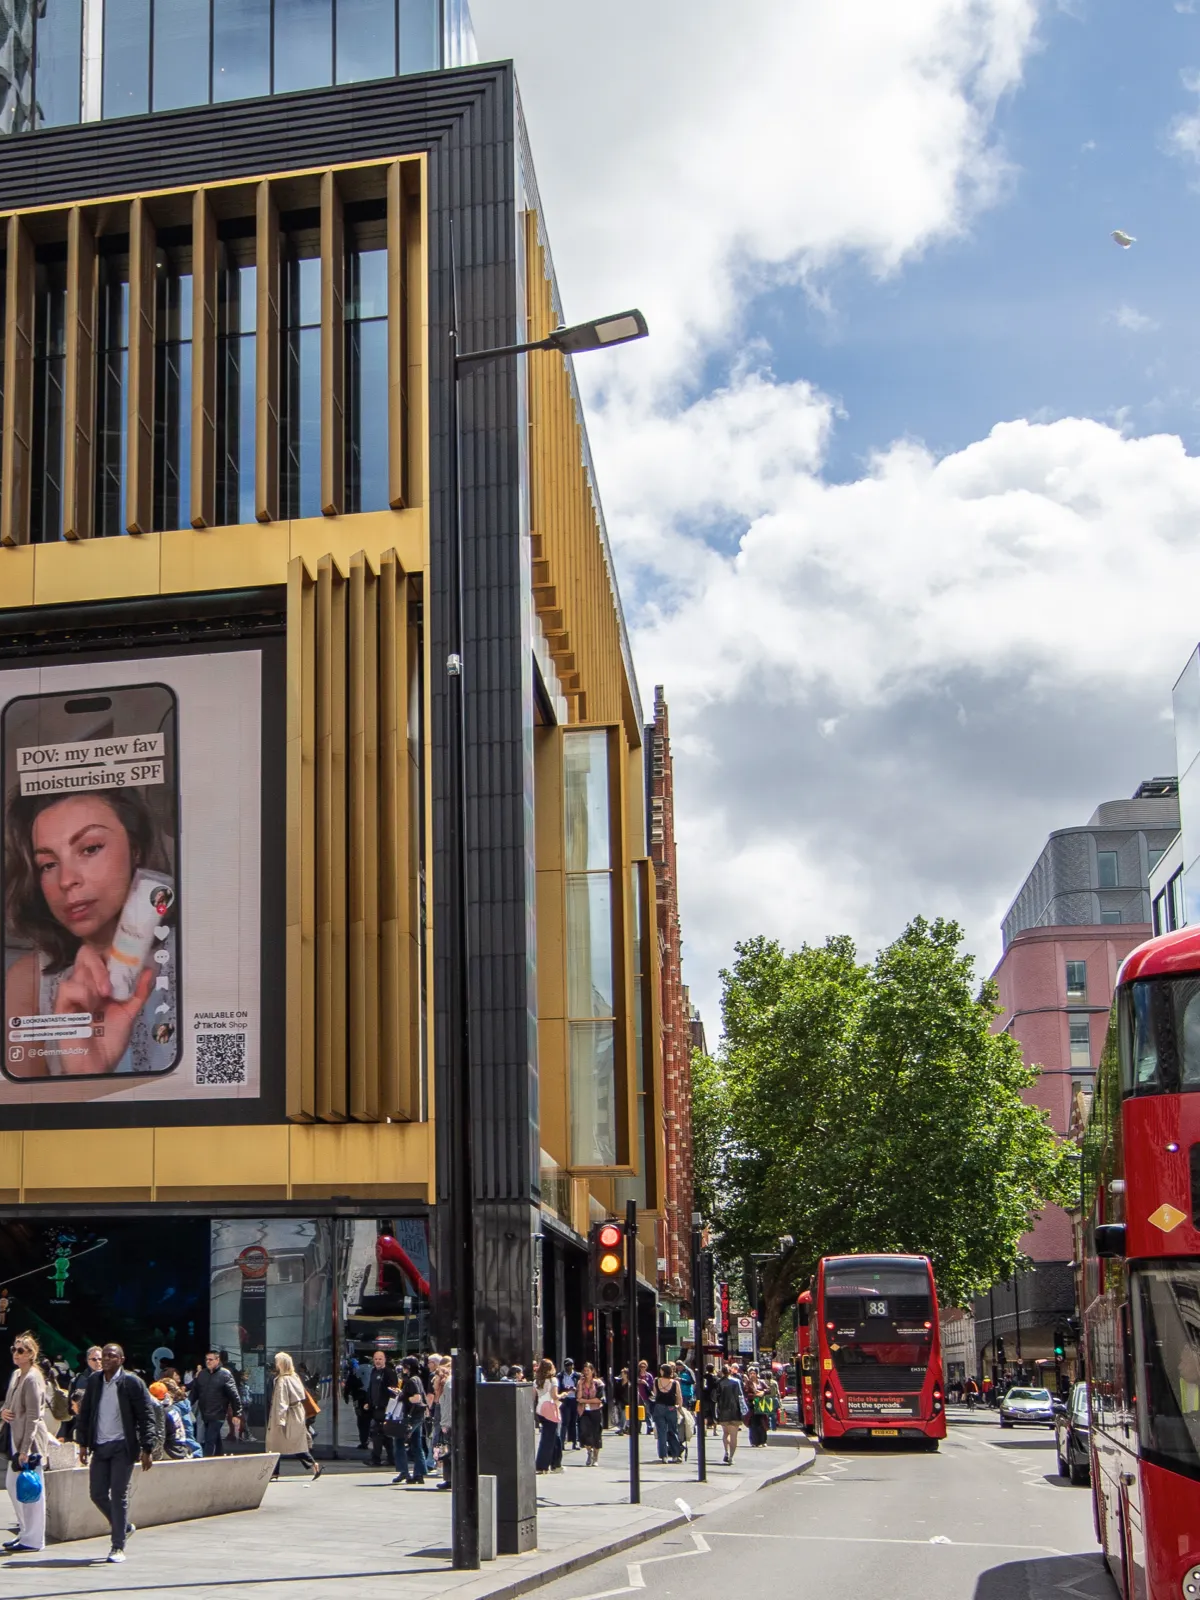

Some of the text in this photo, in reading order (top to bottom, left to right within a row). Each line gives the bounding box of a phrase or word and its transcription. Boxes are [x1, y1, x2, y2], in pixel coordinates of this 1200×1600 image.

[22, 738, 158, 766] POV: my new fav
[25, 764, 162, 793] moisturising SPF
[202, 1021, 248, 1029] TikTok Shop
[869, 1302, 886, 1315] 88
[873, 1402, 902, 1410] spreads.
